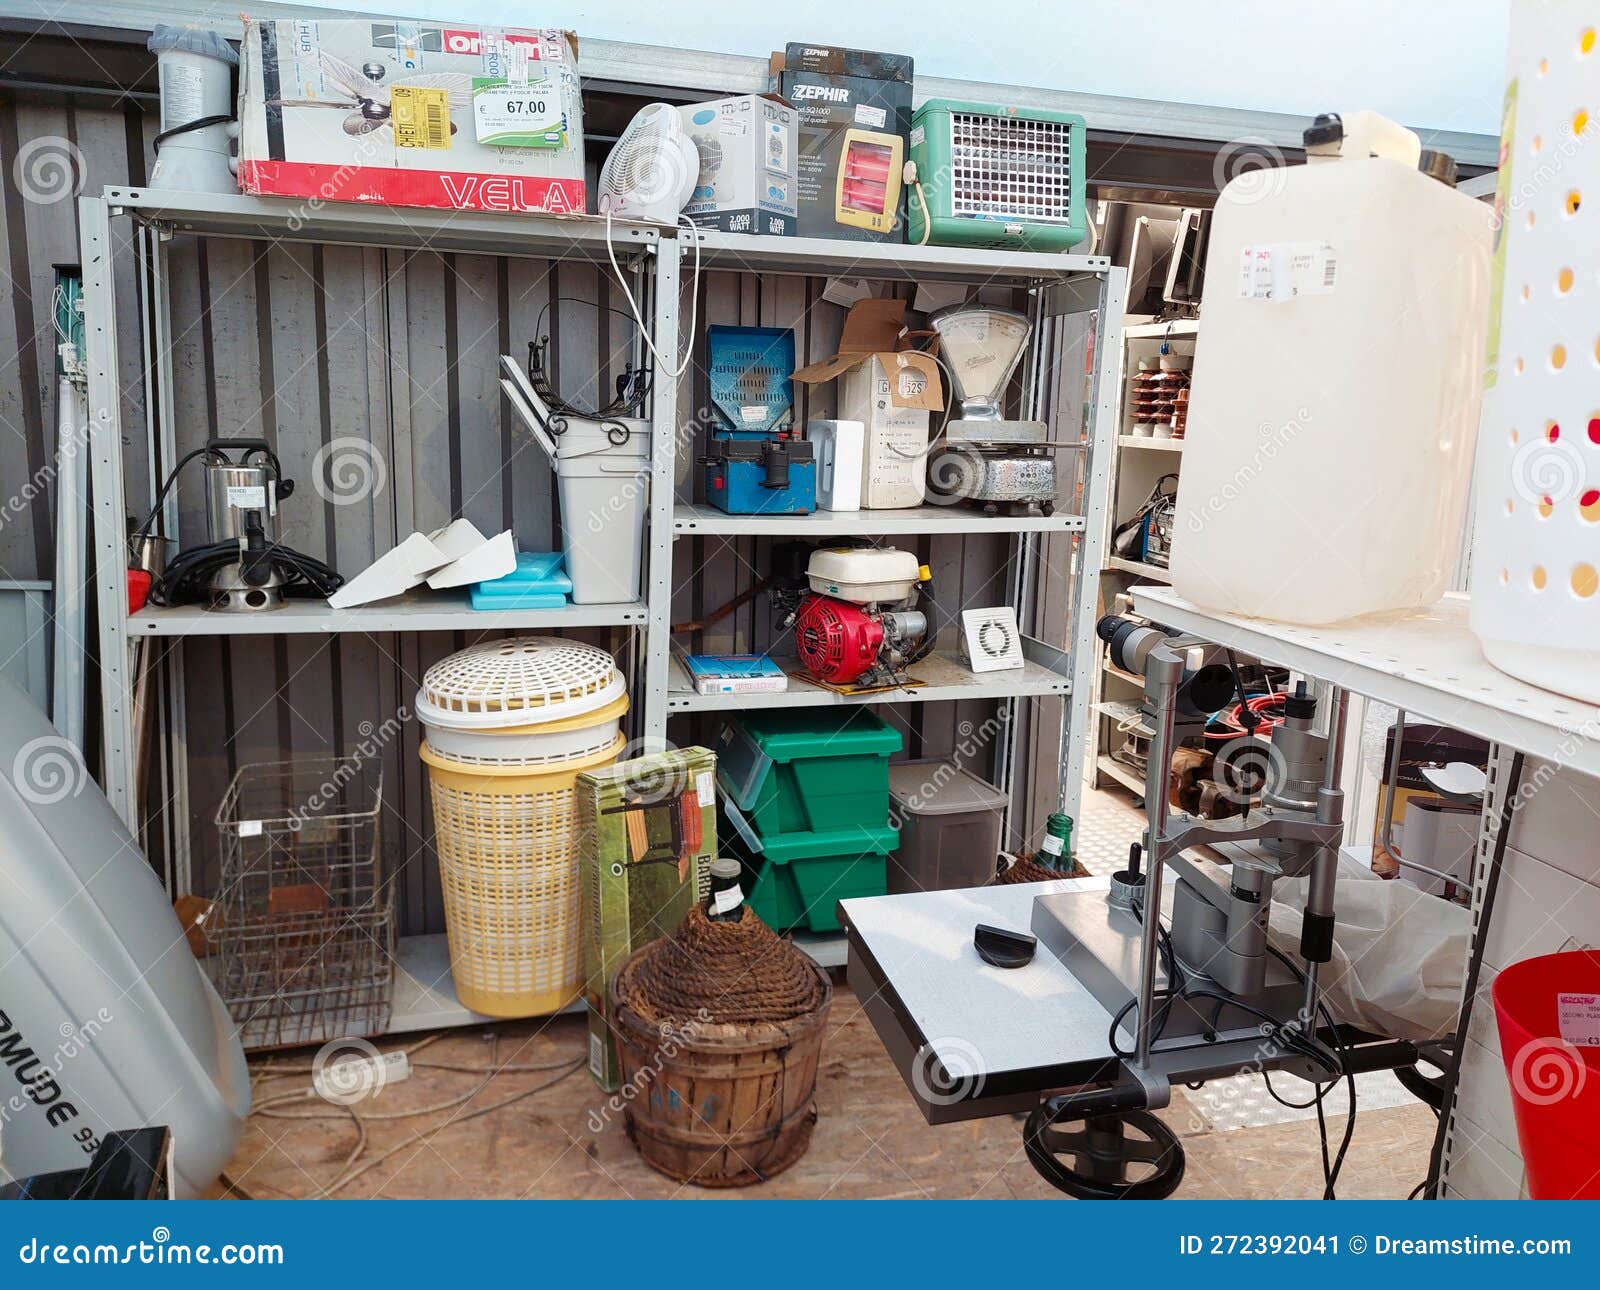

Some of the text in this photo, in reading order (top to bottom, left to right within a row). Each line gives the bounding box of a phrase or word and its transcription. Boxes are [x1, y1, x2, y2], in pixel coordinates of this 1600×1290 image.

[803, 48, 829, 57] ZEPHIR
[791, 84, 849, 102] ZEPHIR
[507, 101, 546, 116] 67,00
[440, 176, 572, 213] VELA
[729, 222, 750, 231] WATT
[769, 224, 785, 235] WATT
